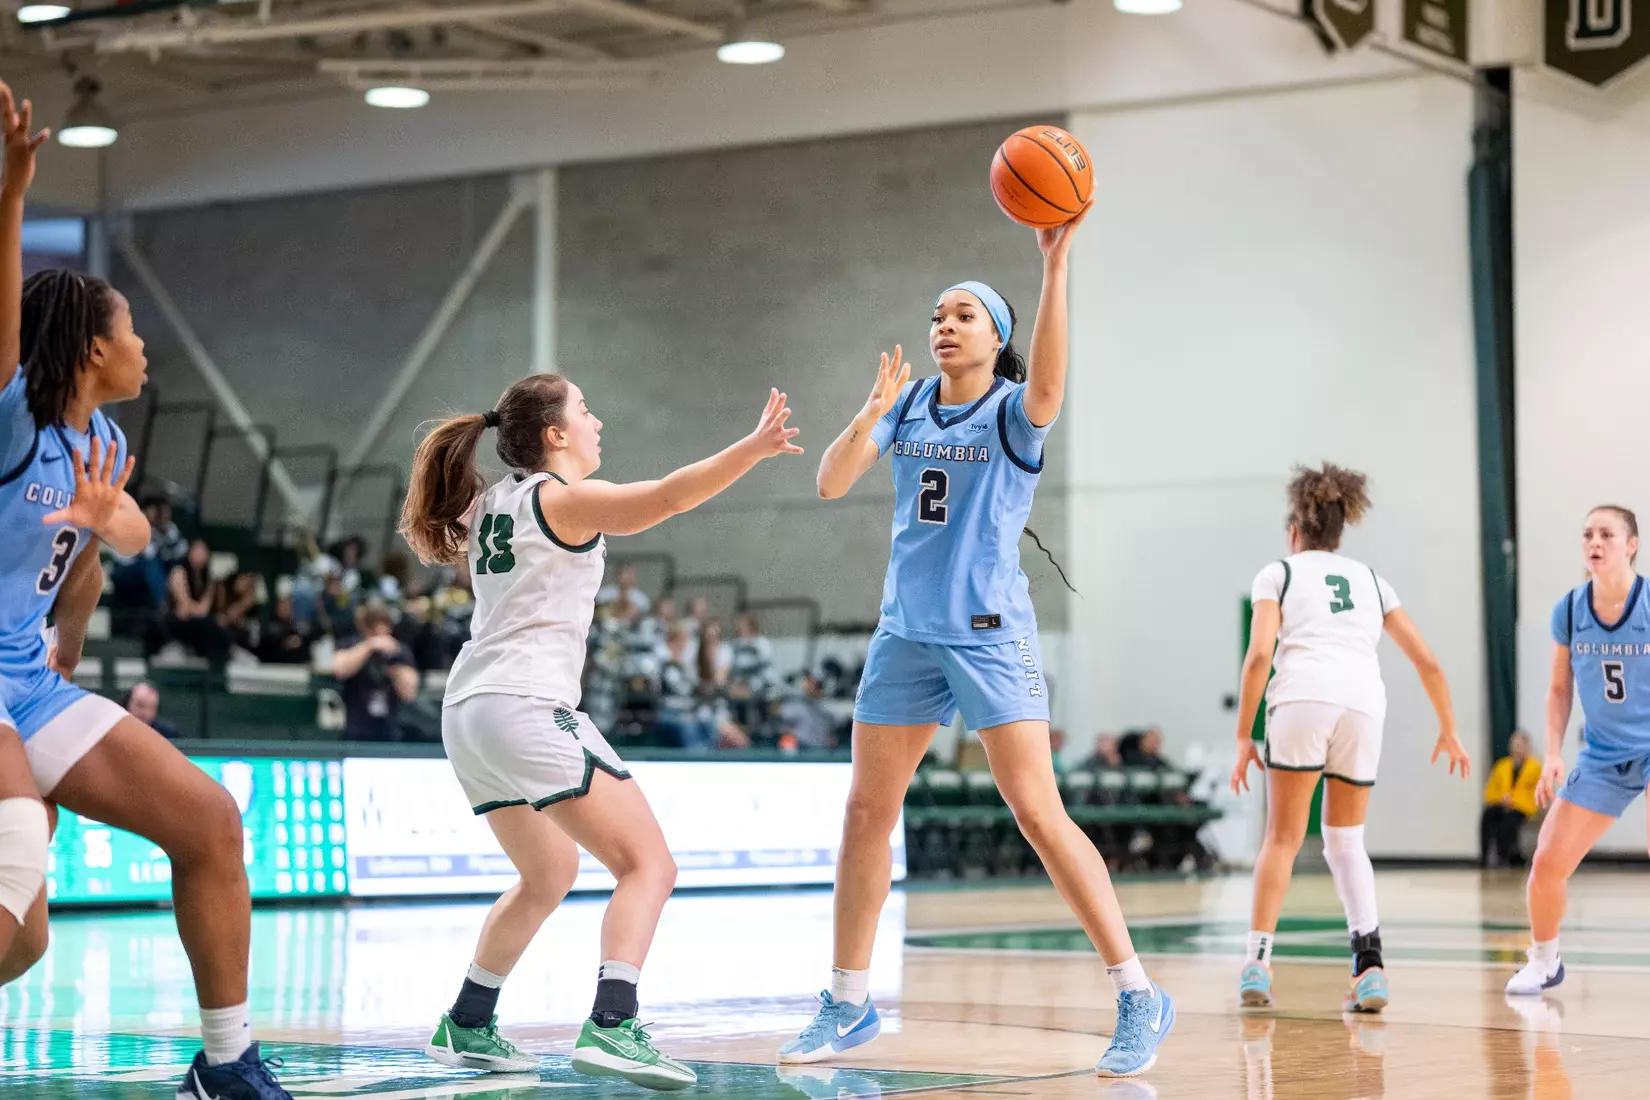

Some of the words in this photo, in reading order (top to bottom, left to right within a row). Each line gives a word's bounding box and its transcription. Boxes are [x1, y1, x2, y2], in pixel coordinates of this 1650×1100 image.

[1042, 128, 1086, 172] ELITE
[894, 440, 990, 462] COLUMBIA
[918, 467, 949, 525] 2
[36, 526, 80, 595] 3
[476, 513, 516, 575] 13
[1325, 574, 1354, 614] 3
[1575, 641, 1650, 656] COLUMBIA
[1601, 660, 1627, 704] 5
